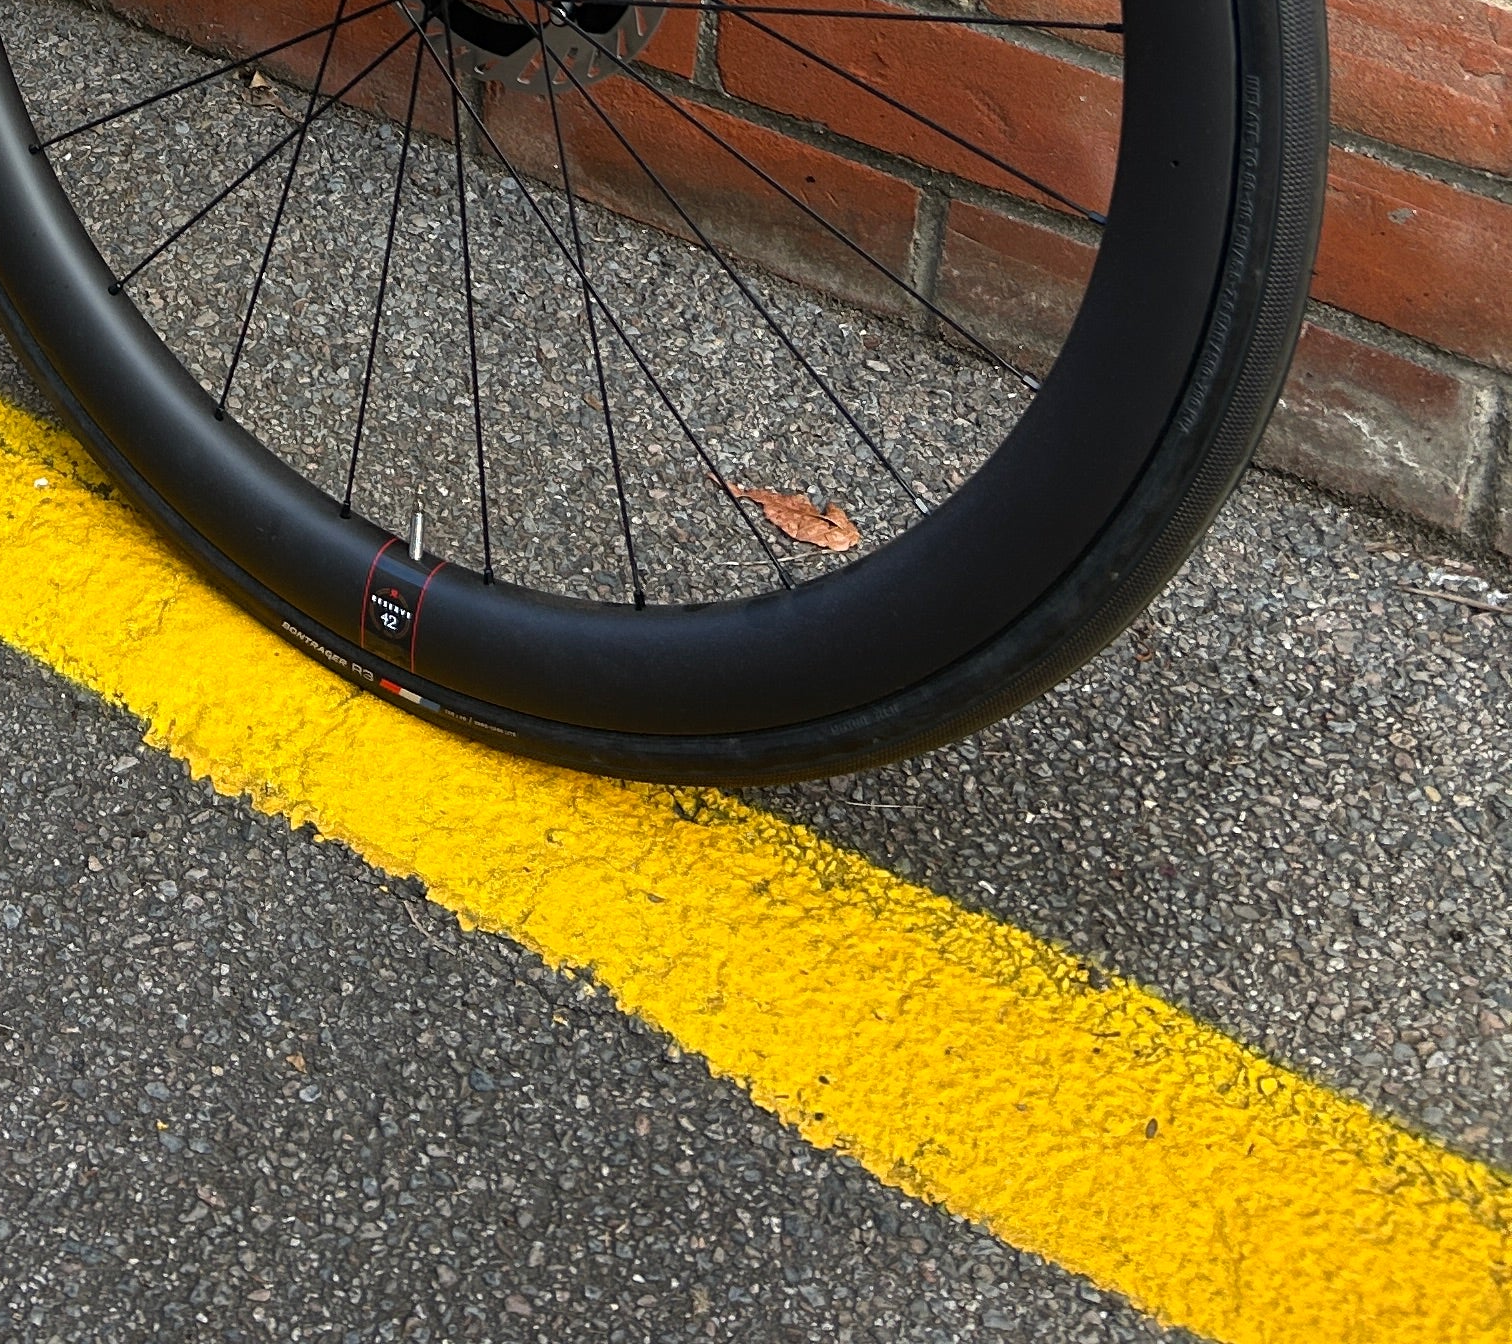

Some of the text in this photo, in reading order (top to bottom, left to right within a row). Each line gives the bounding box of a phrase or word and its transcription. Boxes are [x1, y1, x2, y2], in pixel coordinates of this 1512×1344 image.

[371, 593, 412, 620] RESERVE
[380, 612, 397, 631] 42
[281, 620, 375, 683] BONTRAGER R3
